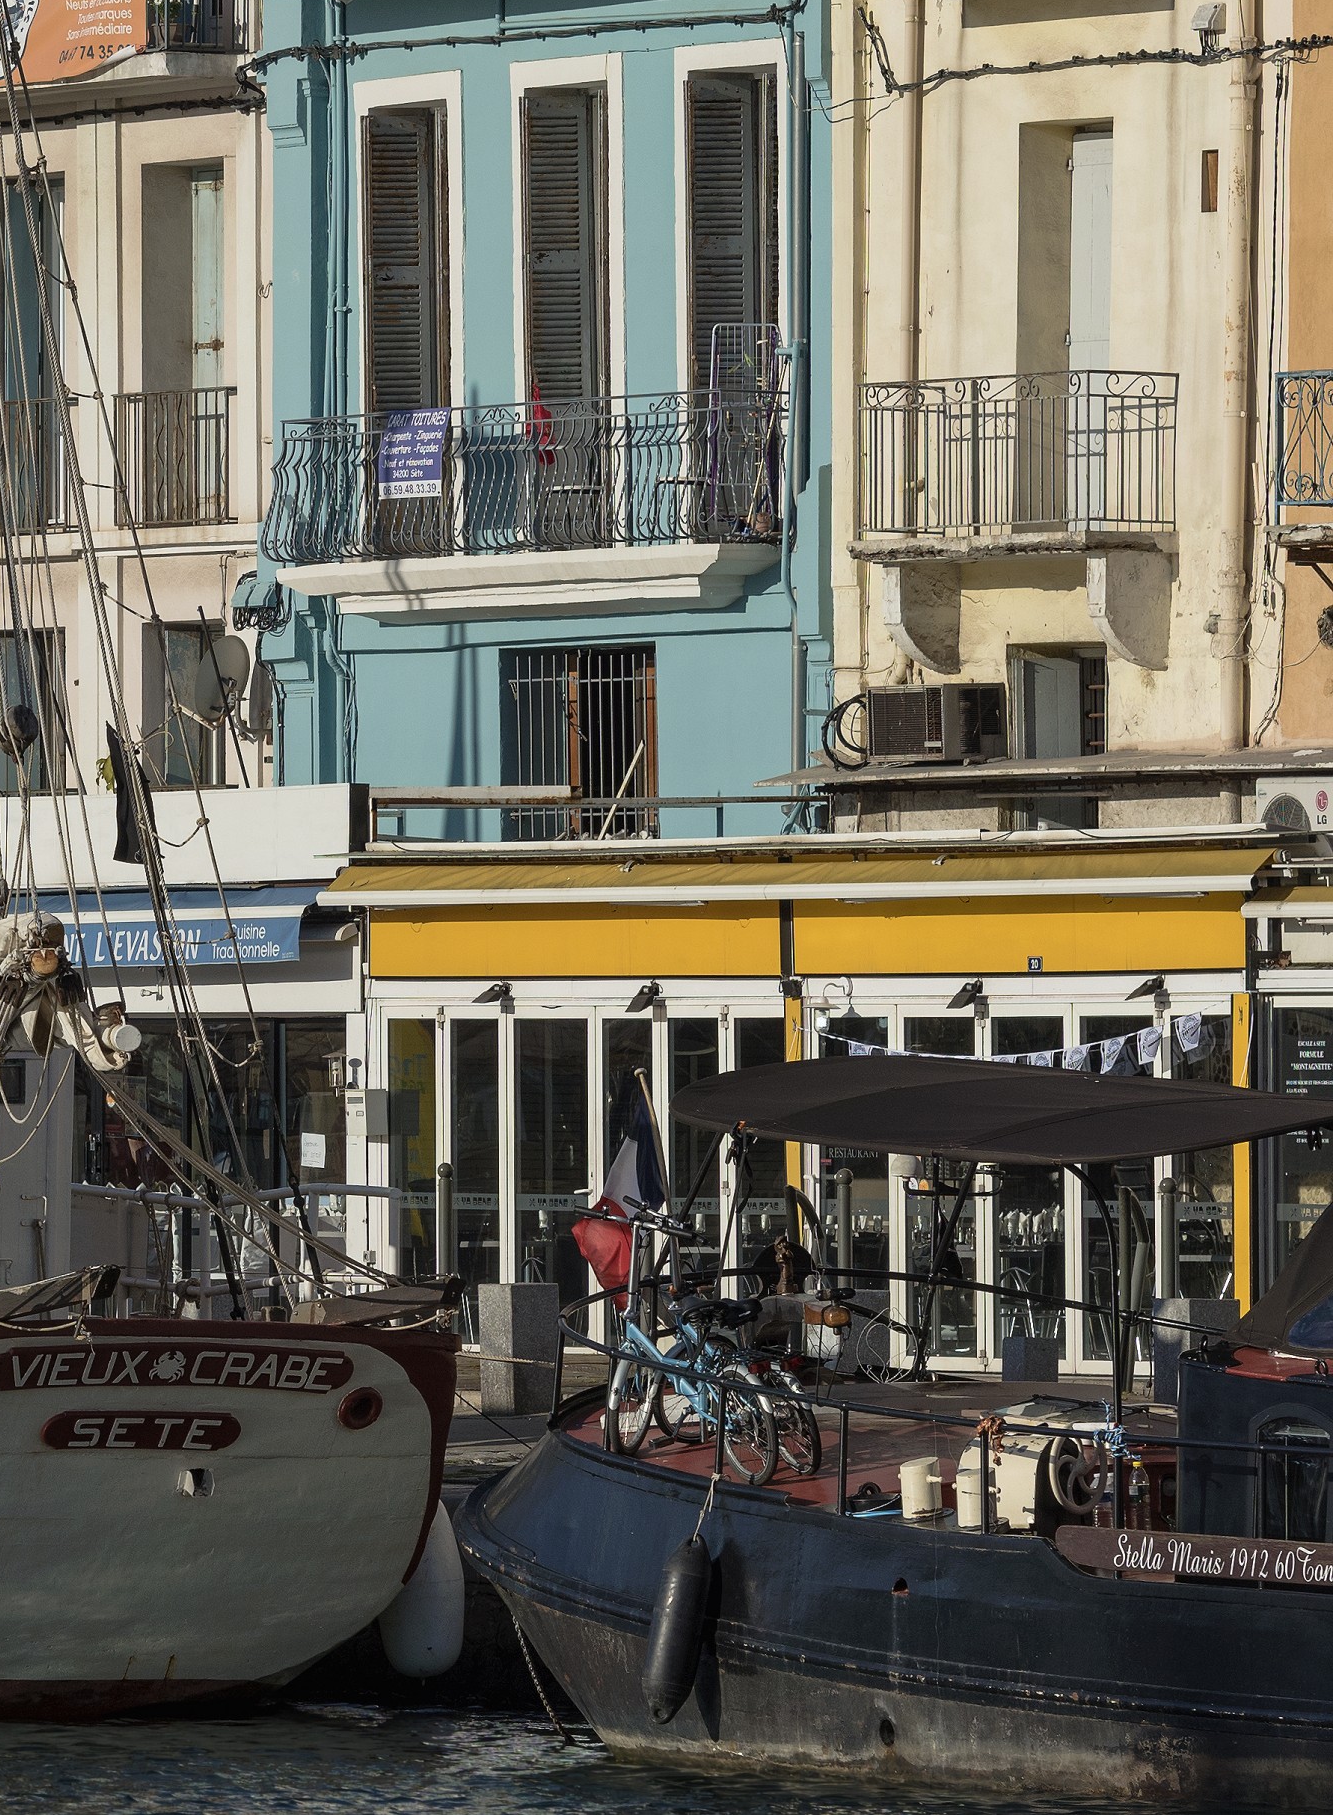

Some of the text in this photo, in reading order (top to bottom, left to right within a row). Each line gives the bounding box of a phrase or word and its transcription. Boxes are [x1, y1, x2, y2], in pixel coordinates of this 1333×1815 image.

[78, 9, 132, 25] Toutes marques
[80, 23, 132, 38] intermédiaire
[79, 44, 95, 60] 74
[98, 44, 114, 59] 35
[387, 411, 447, 428] CARAT TOITURES
[382, 457, 434, 468] Neuf et rénovation
[393, 468, 424, 479] 34200 Sète
[1316, 815, 1328, 825] LG
[231, 923, 266, 940] Cuisine
[1030, 959, 1039, 970] 20
[828, 1147, 879, 1158] RESTAURANT
[10, 1350, 344, 1391] VIEUX CRABE
[66, 1417, 224, 1451] SETE
[1113, 1533, 1165, 1571] Stella
[1167, 1538, 1226, 1576] Maris
[1229, 1547, 1269, 1579] 1912
[1275, 1550, 1296, 1581] 60
